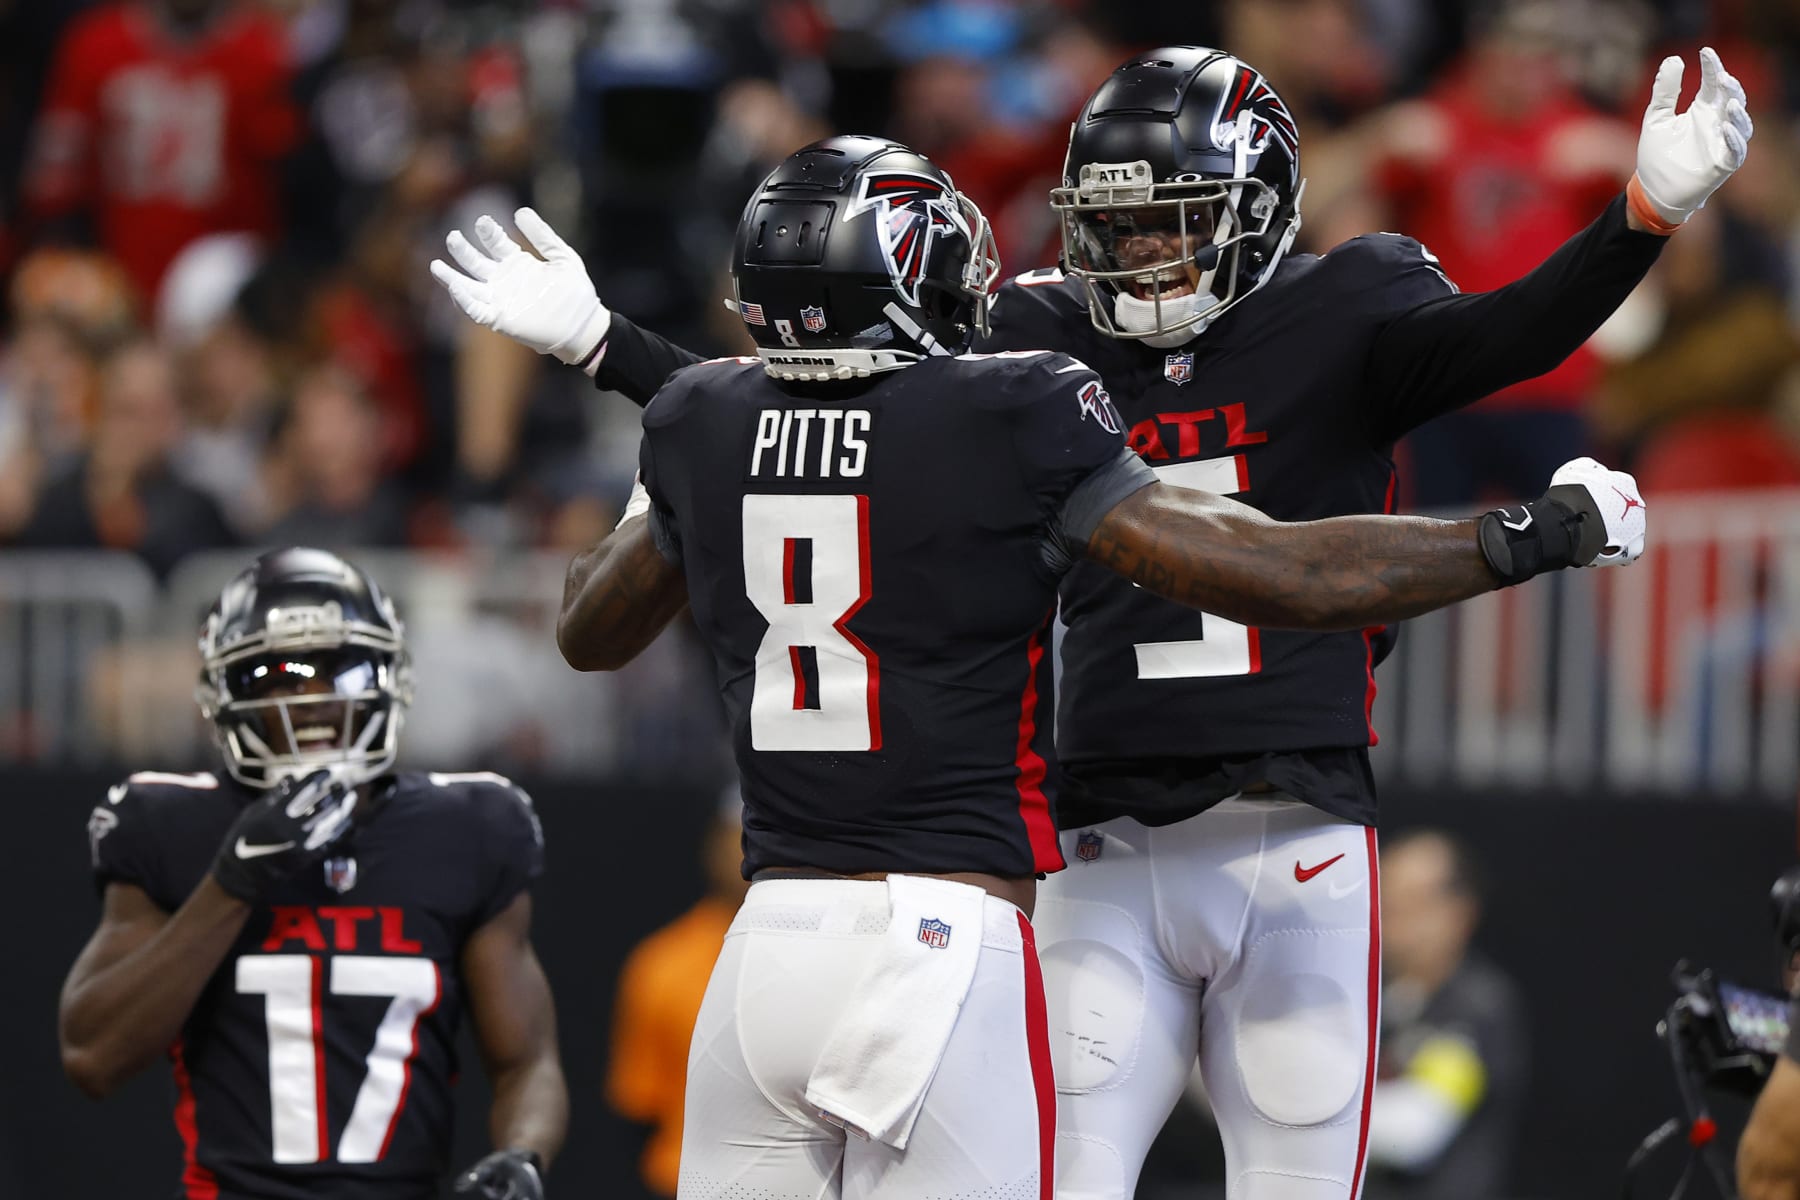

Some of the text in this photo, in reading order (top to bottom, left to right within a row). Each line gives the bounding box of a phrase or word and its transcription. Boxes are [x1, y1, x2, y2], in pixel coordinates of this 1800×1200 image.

[1099, 168, 1133, 182] ATL
[774, 319, 800, 347] 8
[768, 356, 835, 366] FALCONS
[750, 409, 871, 478] PITTS
[1126, 402, 1268, 460] ATL
[742, 494, 882, 752] 8
[261, 905, 422, 954] ATL
[235, 954, 443, 1164] 17
